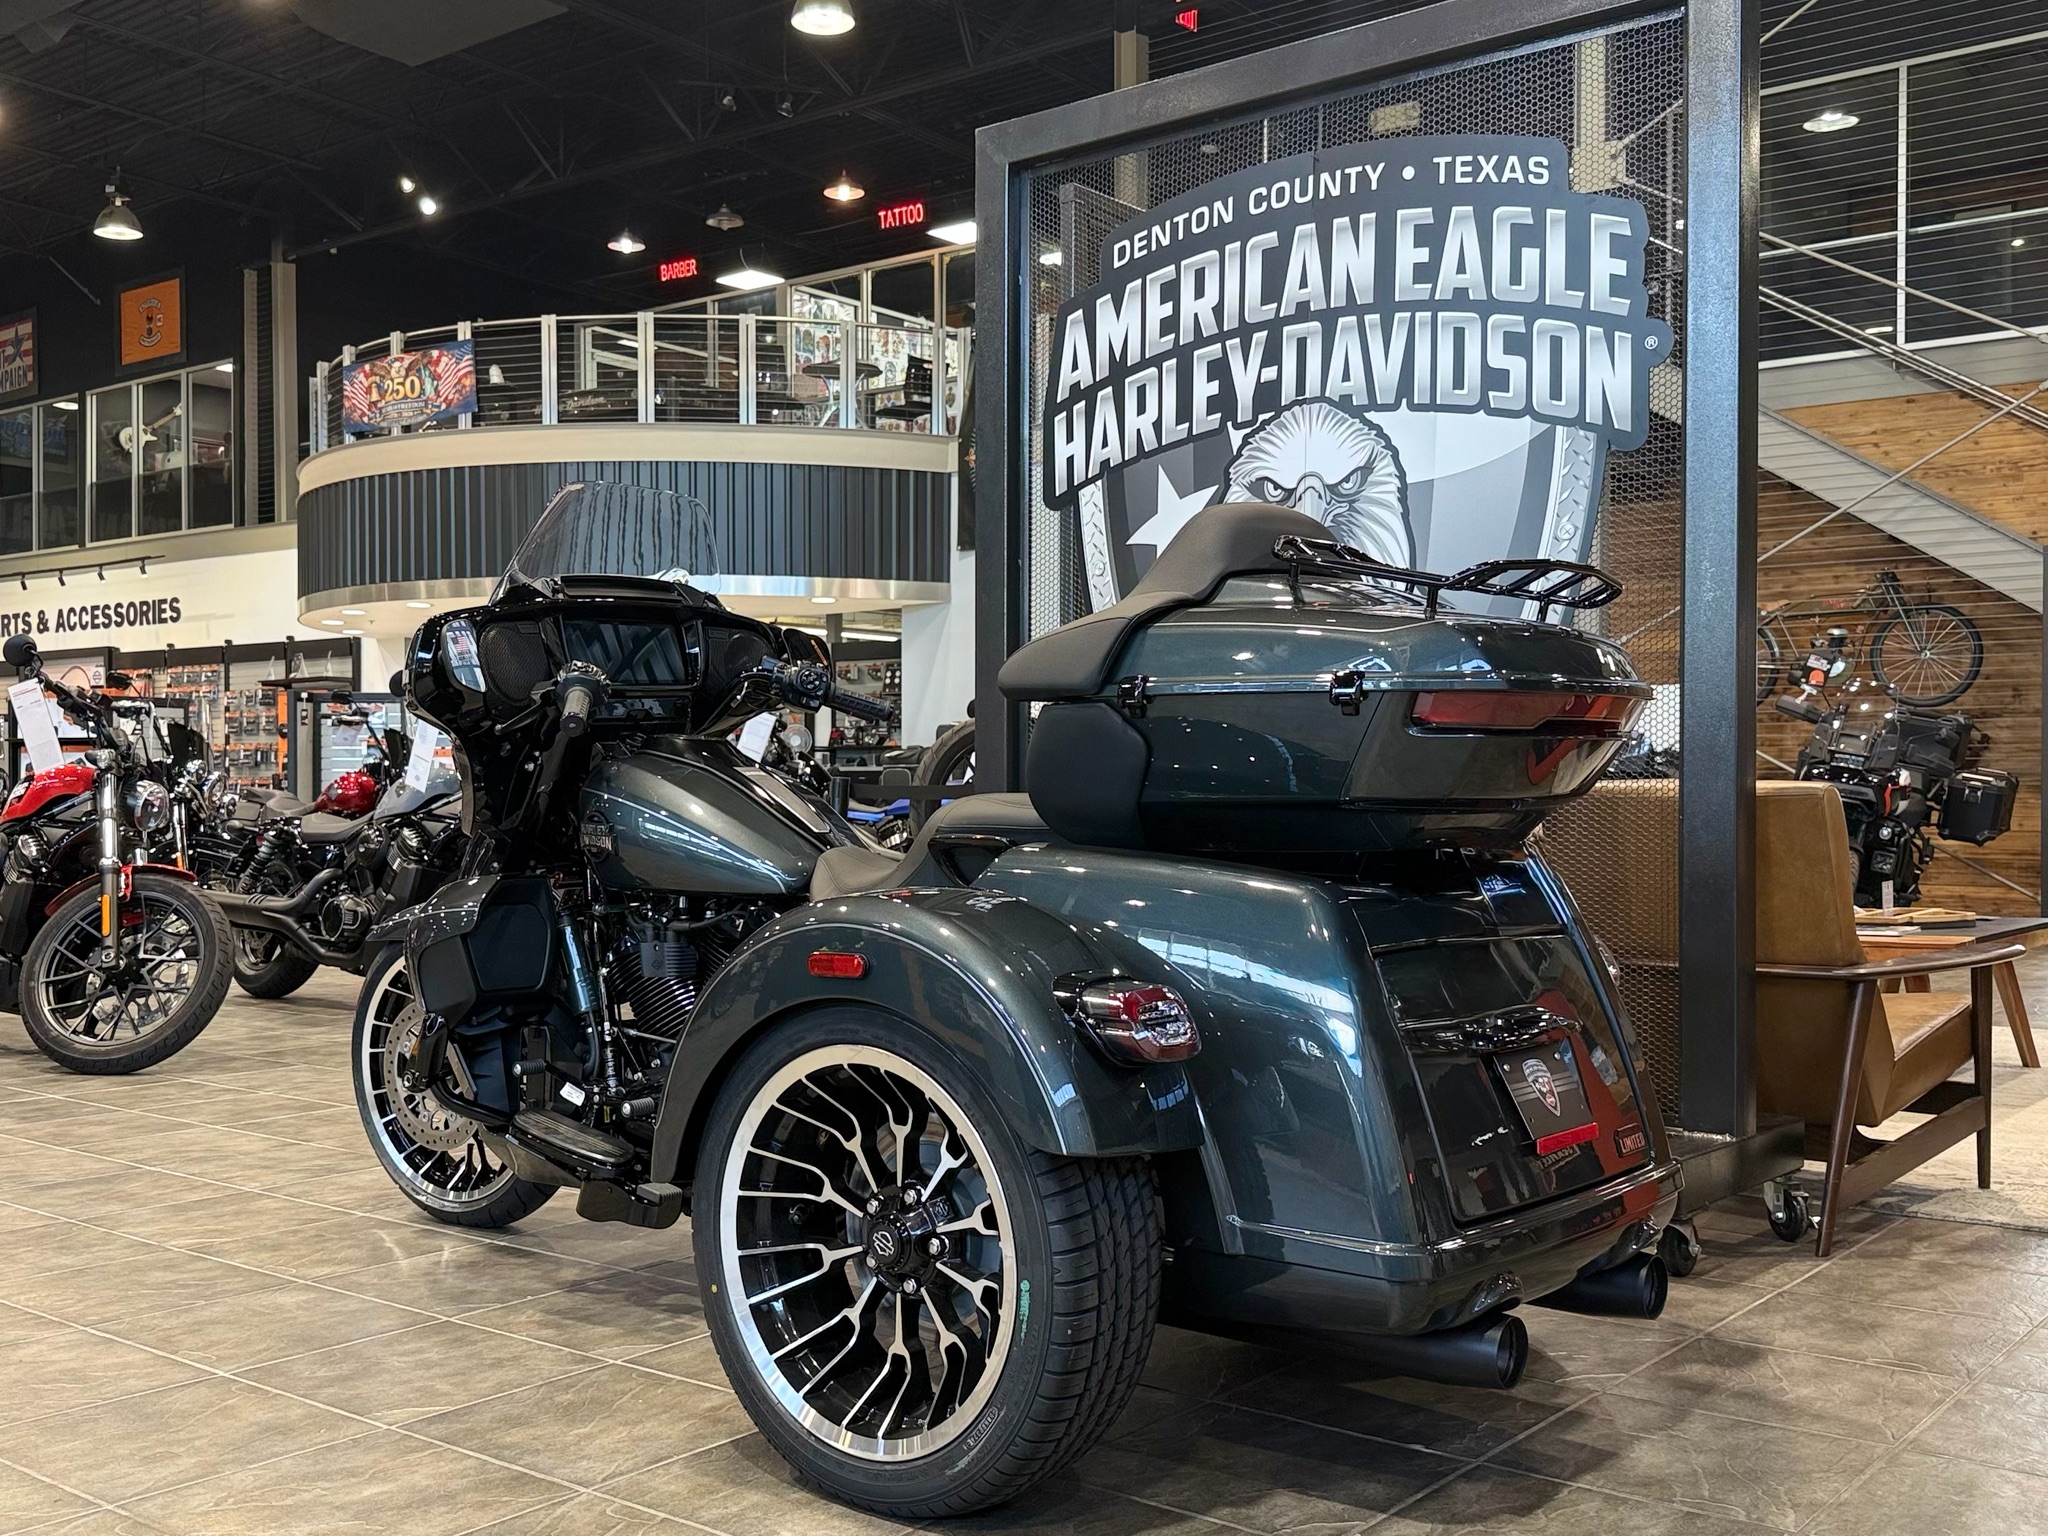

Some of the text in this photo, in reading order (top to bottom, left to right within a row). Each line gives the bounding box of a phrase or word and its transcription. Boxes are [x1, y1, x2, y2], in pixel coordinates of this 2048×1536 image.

[877, 203, 925, 229] TATTOO
[1112, 197, 1235, 270] DENTON
[1247, 163, 1386, 217] COUNTY
[1432, 154, 1551, 186] TEXAS
[660, 258, 698, 282] BARBER
[1056, 205, 1633, 404] AMERICAN EAGLE
[384, 375, 421, 402] 250
[1053, 310, 1633, 498] HARLEY-DAVIDSON
[0, 596, 182, 638] RTS & ACCESSORIES
[1619, 1131, 1646, 1154] LIMITED
